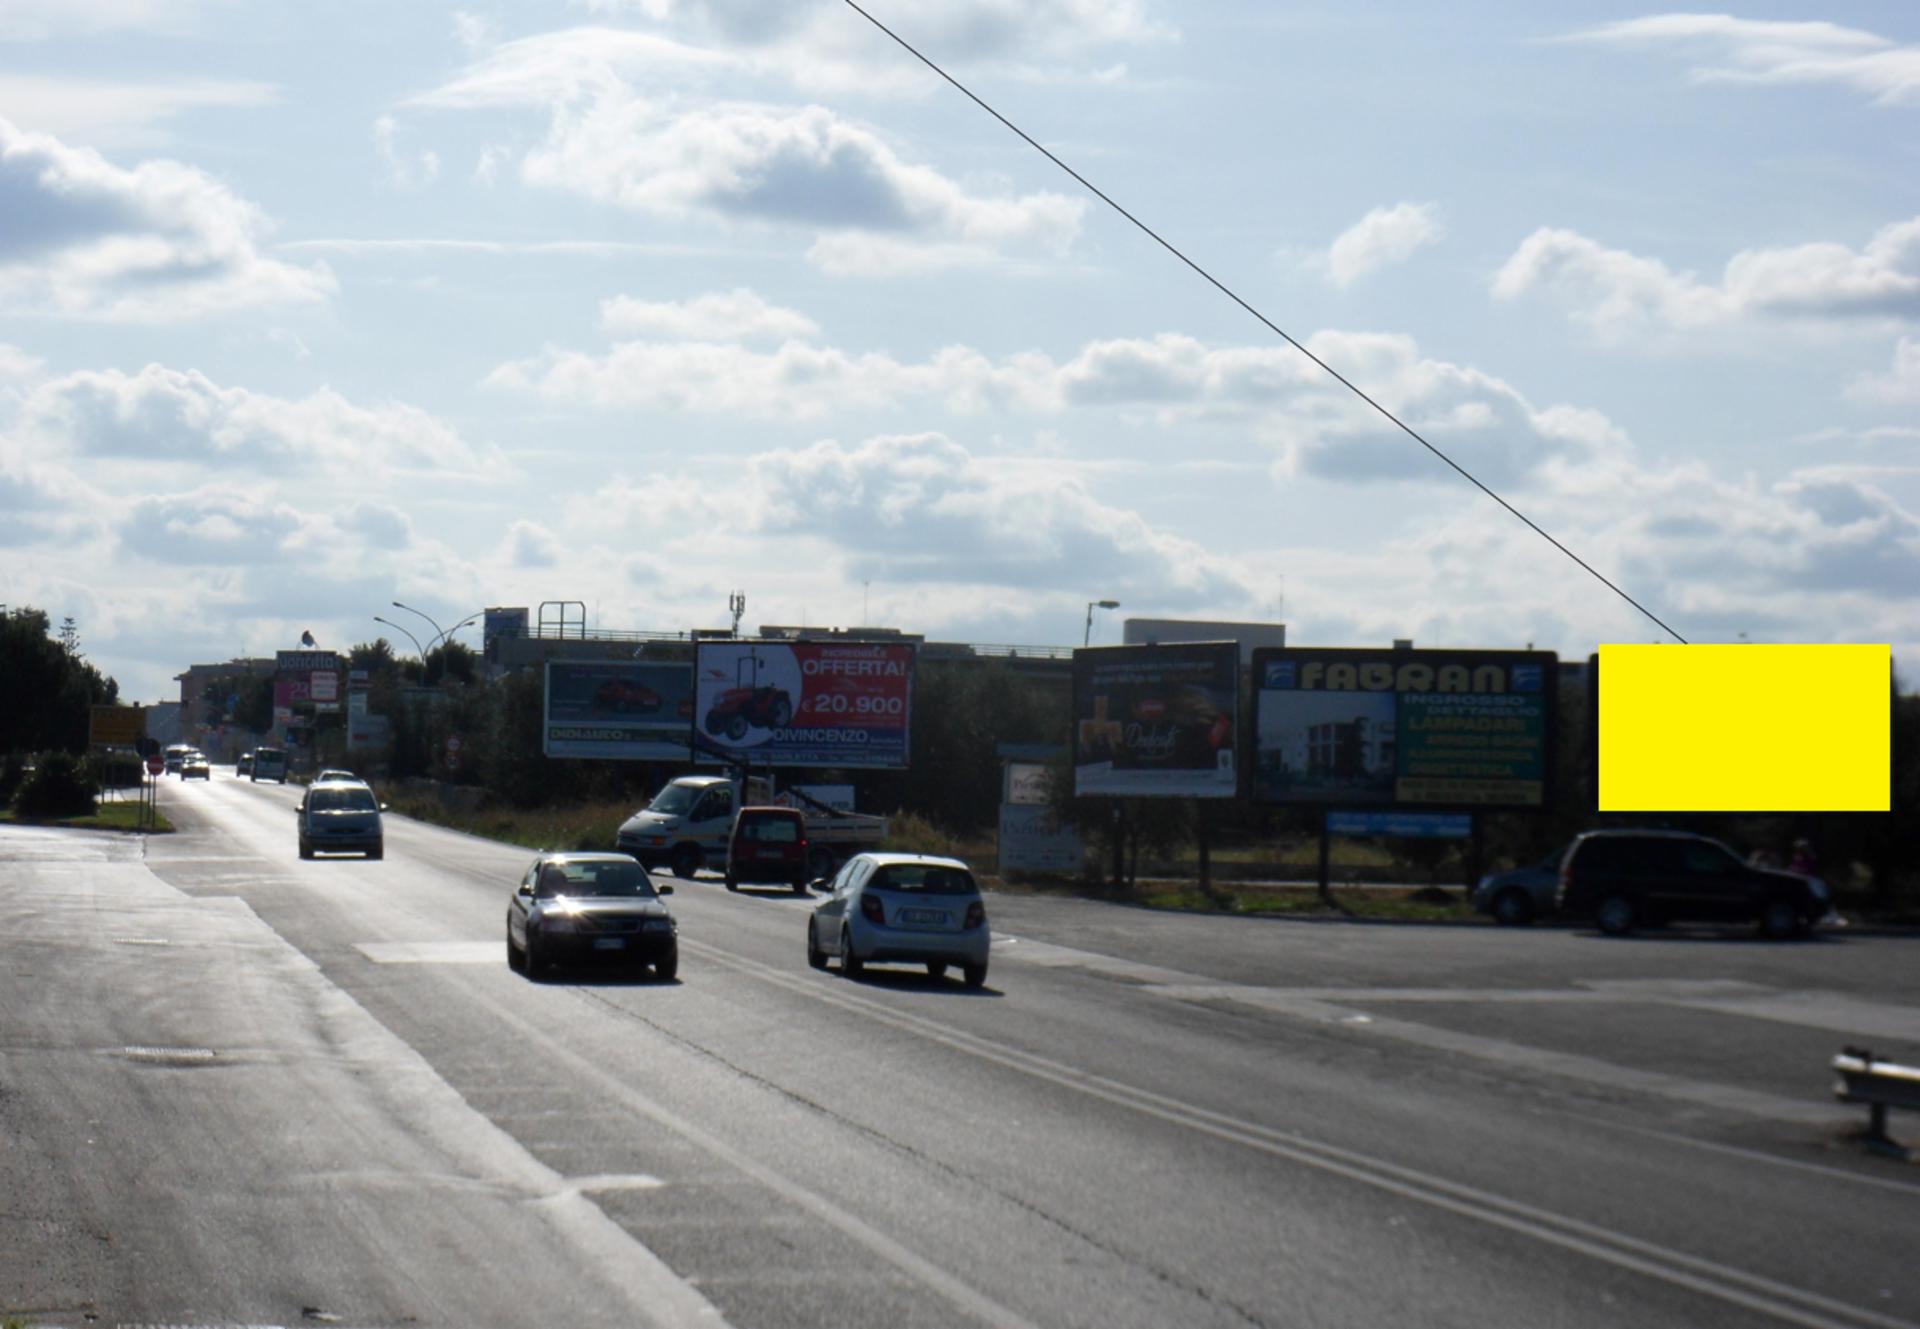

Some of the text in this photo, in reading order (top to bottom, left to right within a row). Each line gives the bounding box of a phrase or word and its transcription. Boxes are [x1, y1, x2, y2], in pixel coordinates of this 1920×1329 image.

[802, 659, 905, 677] OFFERTA!
[814, 693, 903, 715] 20.900
[1403, 693, 1525, 706] INGROSSO
[1427, 705, 1540, 717] DETTAGLIO
[773, 727, 869, 743] DIVINCENZO
